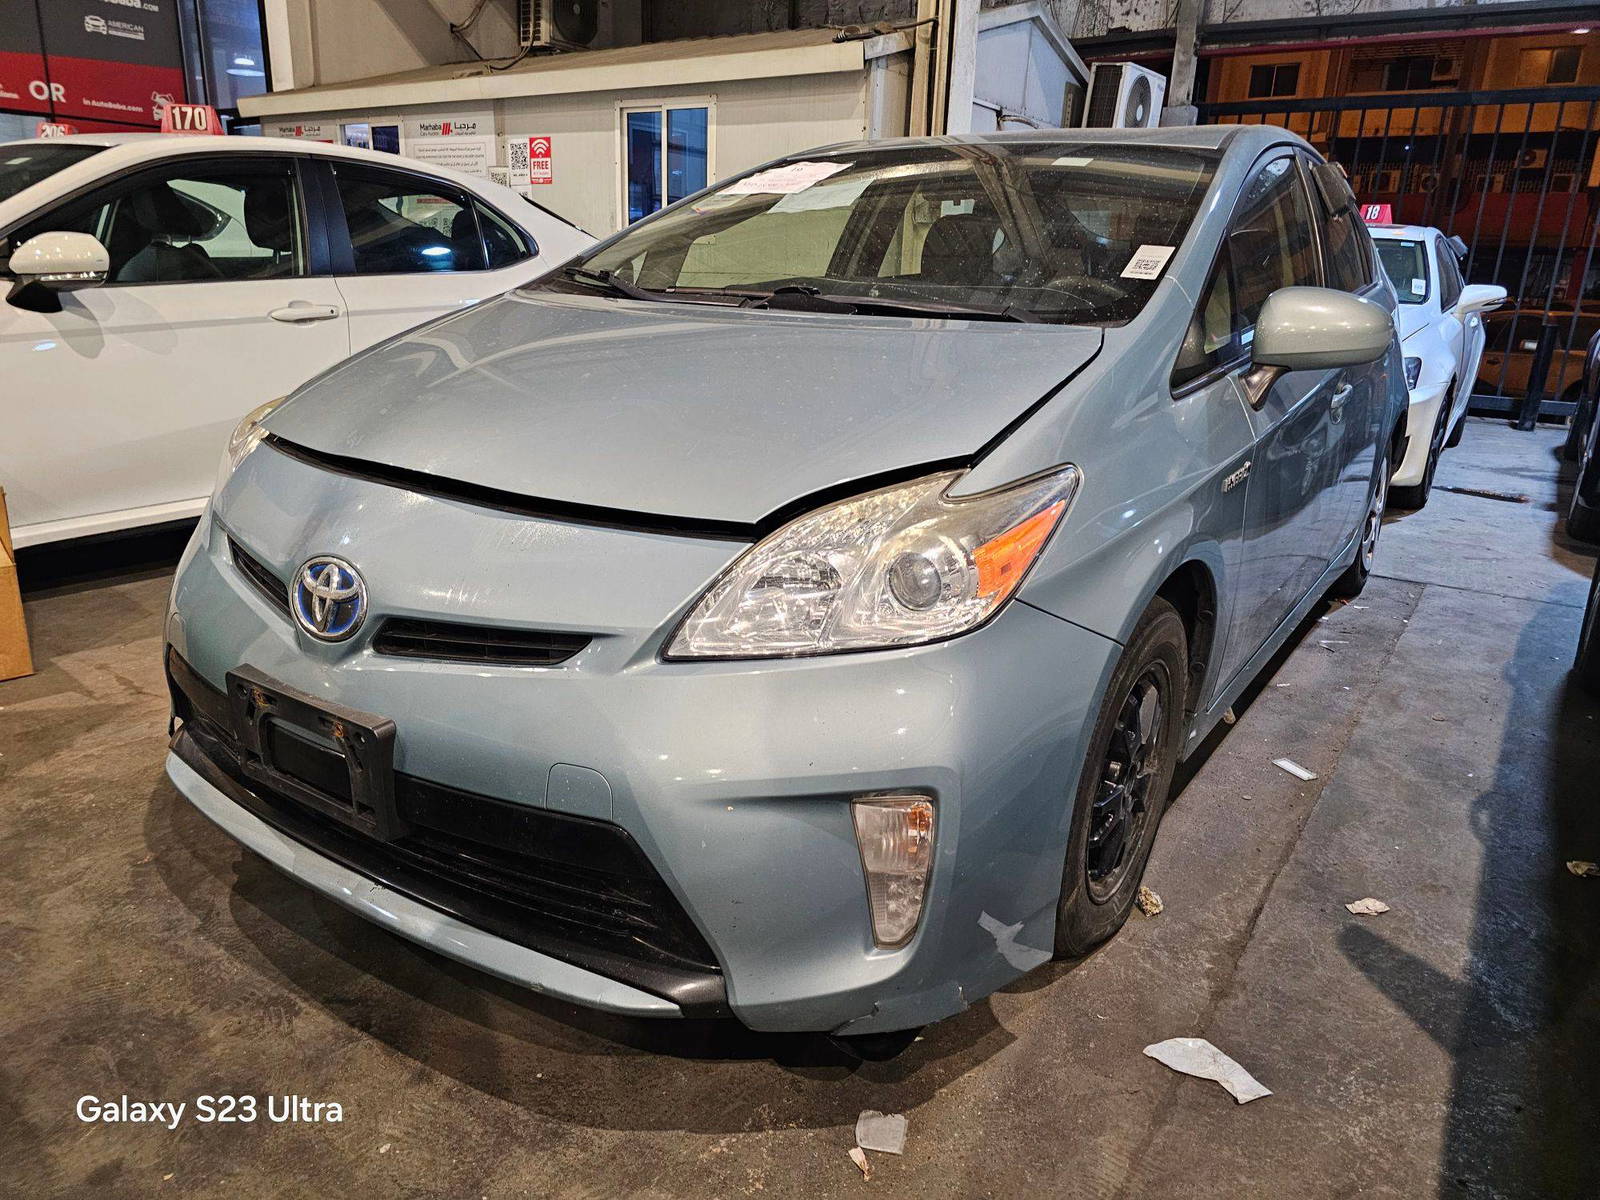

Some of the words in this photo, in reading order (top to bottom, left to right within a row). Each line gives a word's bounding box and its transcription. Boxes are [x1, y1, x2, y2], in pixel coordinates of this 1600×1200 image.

[29, 80, 66, 103] OR
[172, 106, 207, 130] 170
[41, 124, 65, 137] 206
[533, 161, 549, 169] FREE
[1366, 205, 1380, 220] 18
